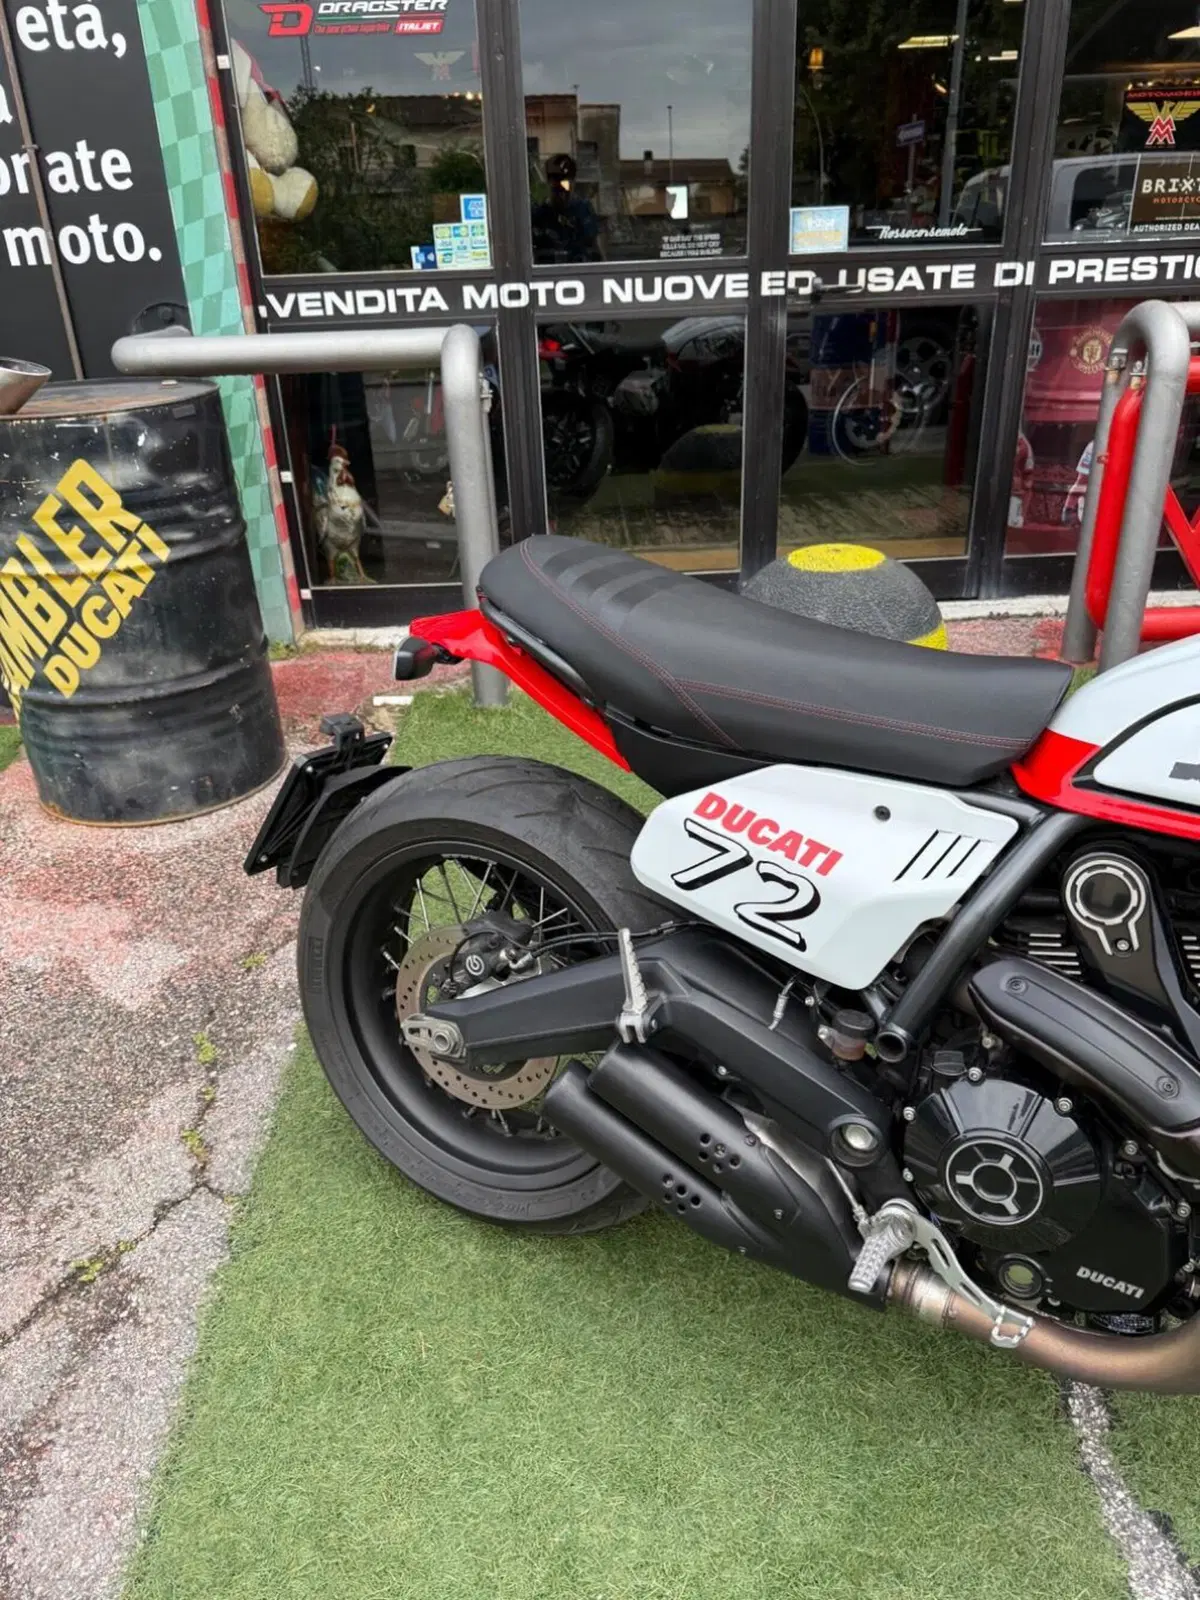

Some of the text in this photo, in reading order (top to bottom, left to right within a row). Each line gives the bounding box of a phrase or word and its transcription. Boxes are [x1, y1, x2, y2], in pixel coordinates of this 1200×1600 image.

[317, 0, 448, 14] DRAGSTER
[399, 21, 440, 32] ITALJET
[2, 213, 162, 266] moto.
[1133, 223, 1183, 233] AUTHORIZED
[462, 280, 586, 311] MOTO
[602, 273, 749, 304] NUOVE
[761, 269, 816, 296] ED
[838, 263, 977, 294] USATE
[993, 261, 1035, 287] DI
[1048, 254, 1200, 284] PRESTI
[43, 523, 171, 698] DUCATI
[693, 791, 844, 877] DUCATI
[670, 817, 822, 953] 72
[1076, 1265, 1145, 1299] DUCATI
